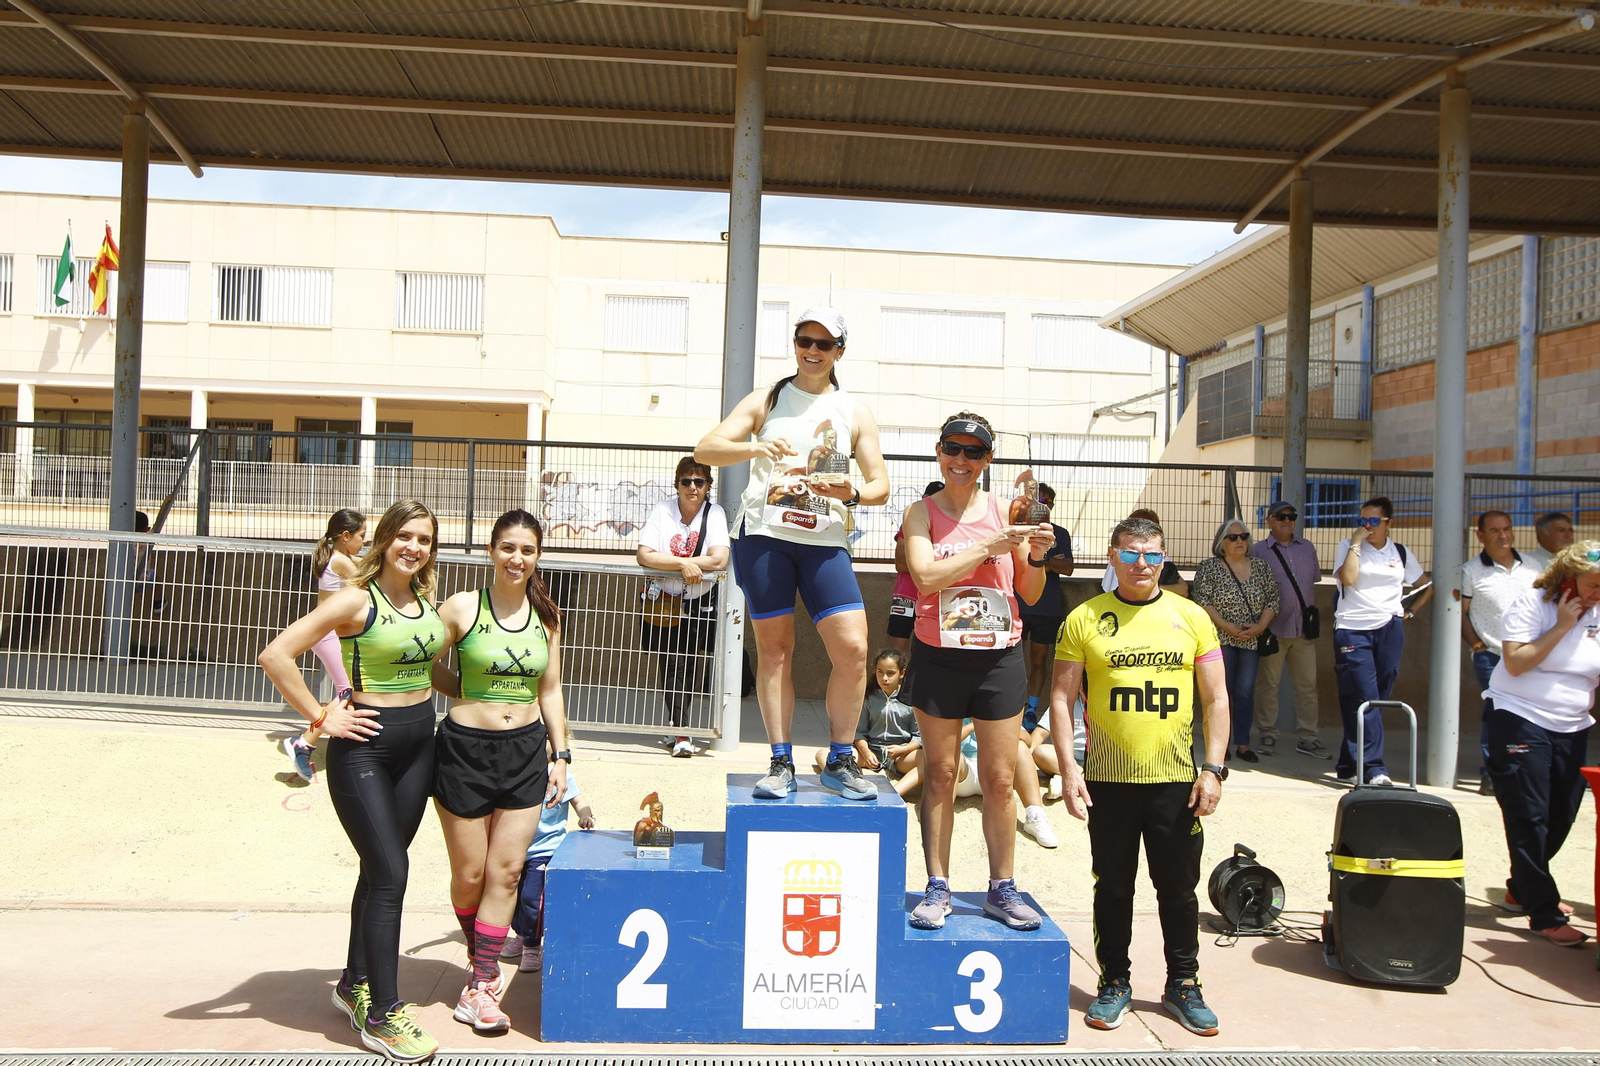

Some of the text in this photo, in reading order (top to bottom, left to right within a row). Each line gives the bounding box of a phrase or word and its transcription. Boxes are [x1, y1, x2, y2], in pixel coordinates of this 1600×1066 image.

[951, 597, 991, 617] 150
[1110, 652, 1183, 668] SPORTGYM
[1110, 681, 1179, 719] mtp
[616, 908, 669, 1009] 2
[1389, 960, 1413, 968] VONYX
[752, 968, 867, 993] ALMERÍA
[780, 996, 839, 1010] CIUDAD
[953, 950, 1003, 1034] 3
